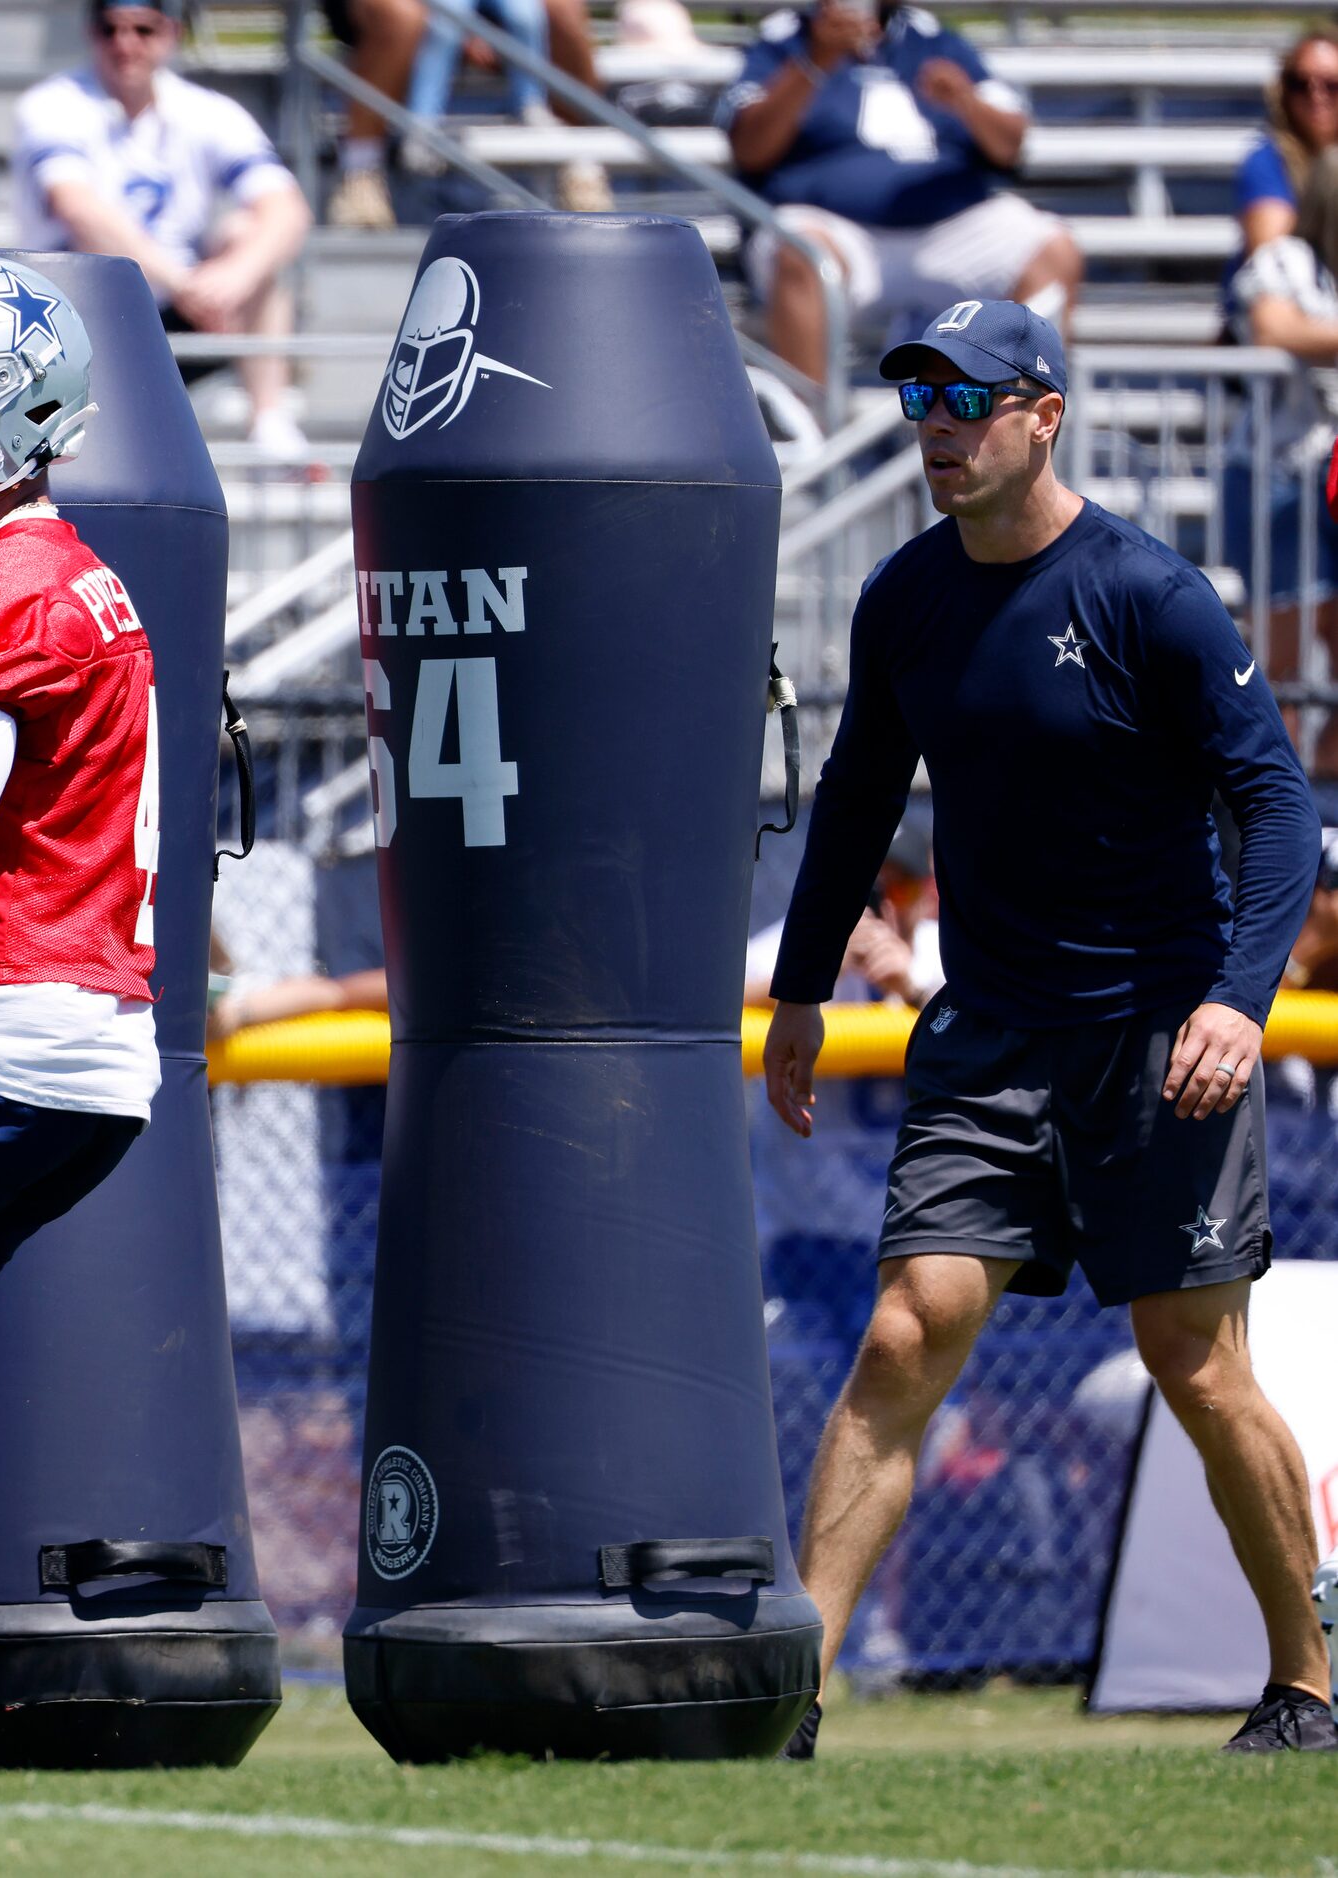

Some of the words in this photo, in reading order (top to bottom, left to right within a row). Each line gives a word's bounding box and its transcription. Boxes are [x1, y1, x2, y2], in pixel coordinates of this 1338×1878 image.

[936, 300, 984, 332] D
[376, 1457, 411, 1480] ATHLETIC
[410, 1466, 430, 1533] COMPANY
[380, 1479, 410, 1545] R
[374, 1545, 417, 1569] ROGERS
